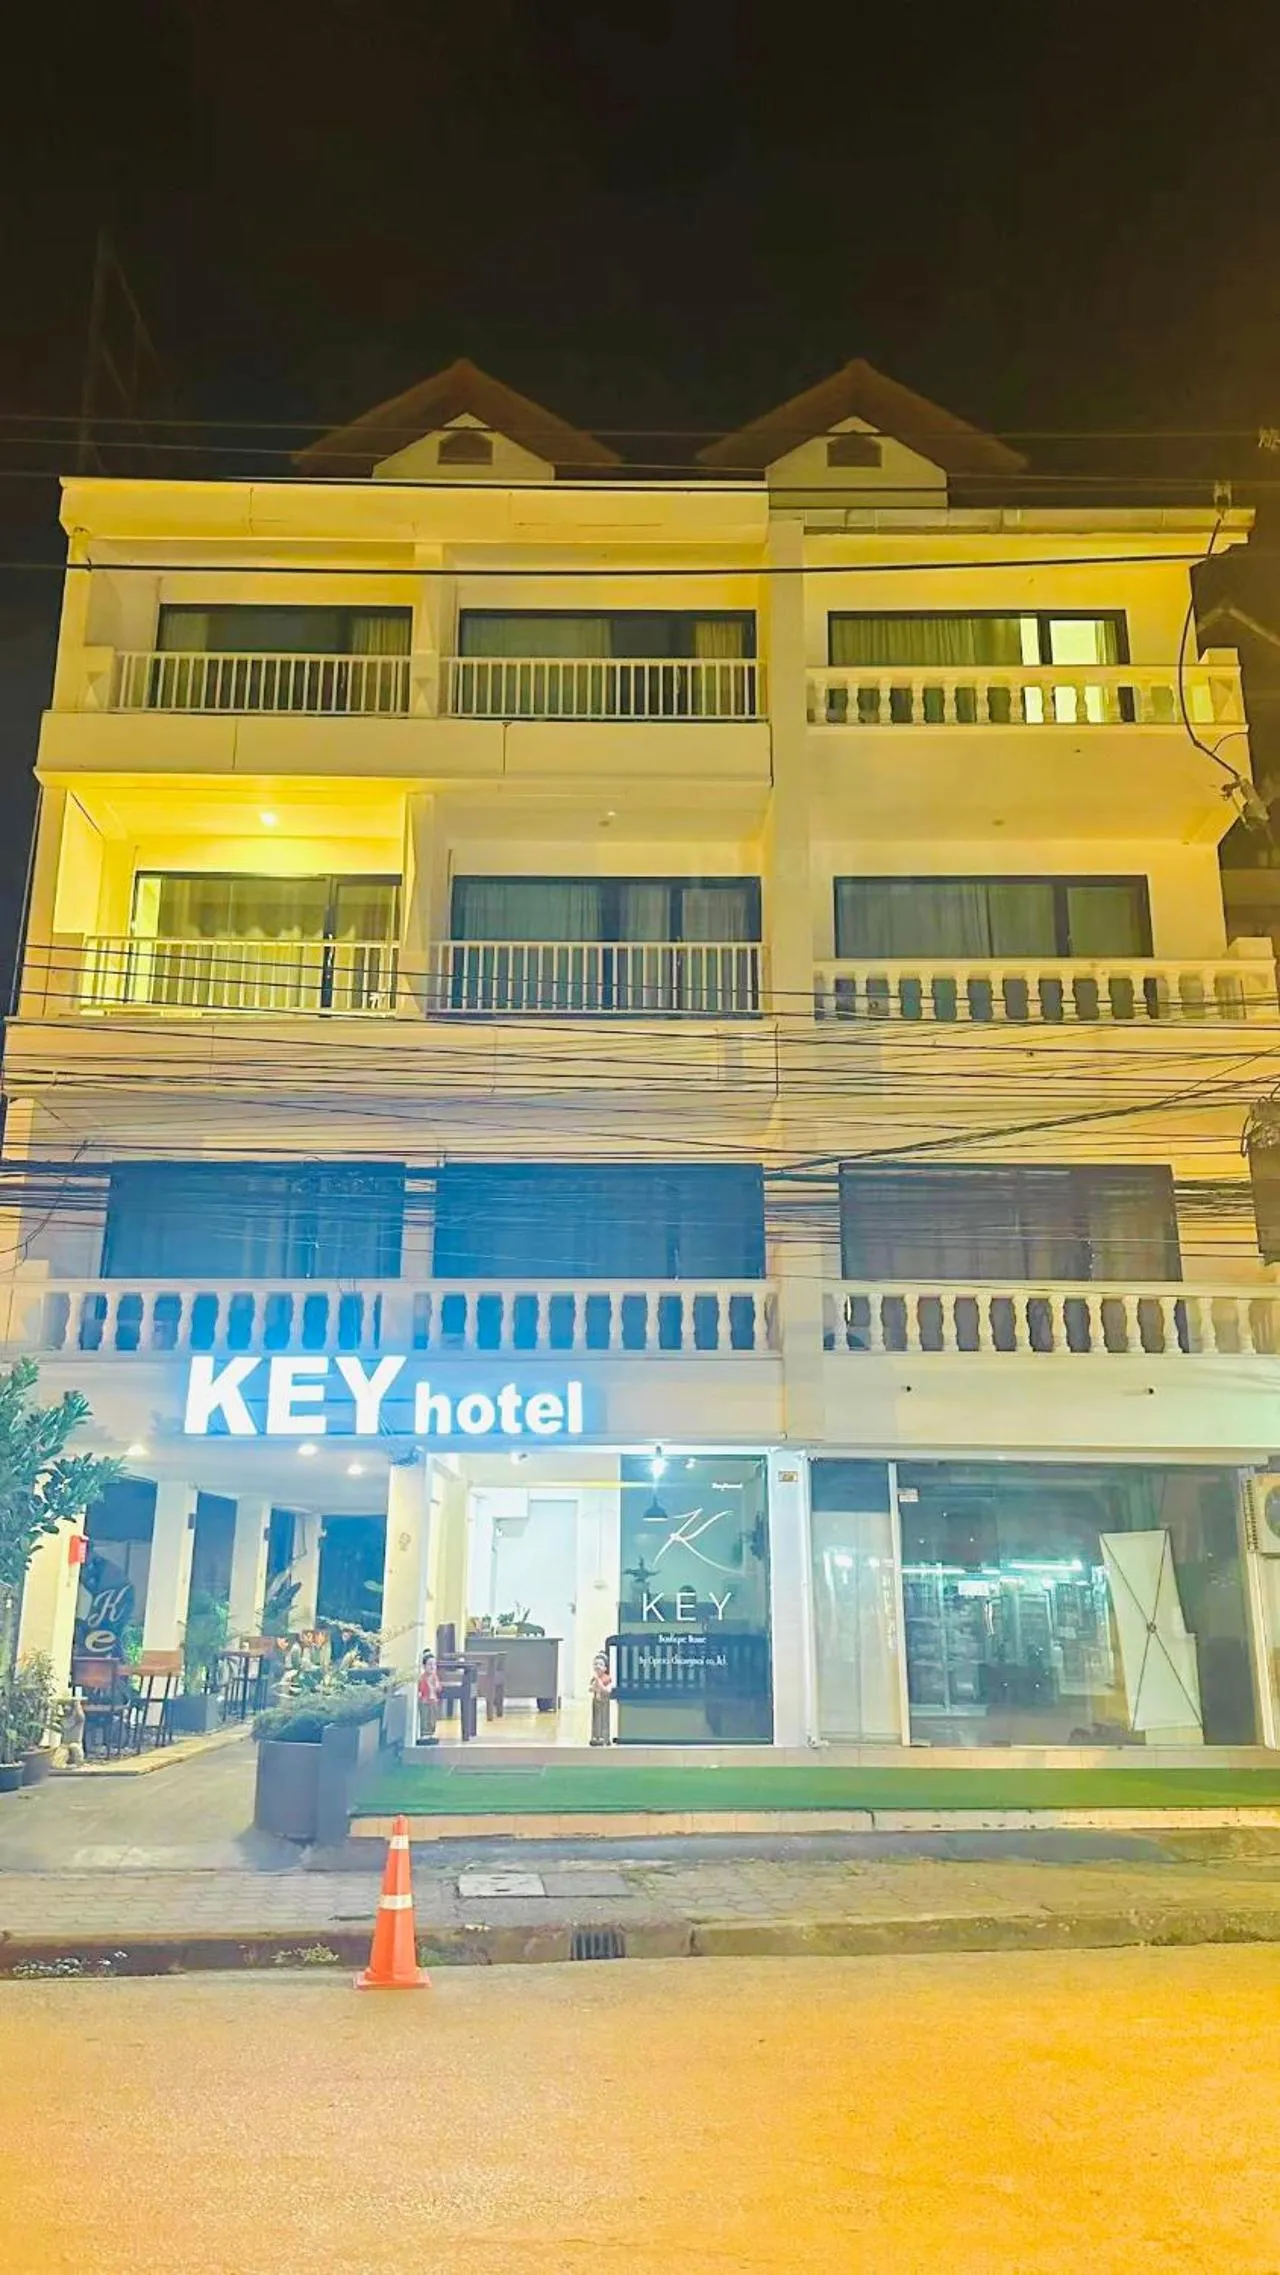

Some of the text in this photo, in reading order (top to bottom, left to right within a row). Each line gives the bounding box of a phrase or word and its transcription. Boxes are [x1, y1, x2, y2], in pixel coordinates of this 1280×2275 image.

[184, 1355, 583, 1435] KEY hotel
[642, 1592, 732, 1622] KEY
